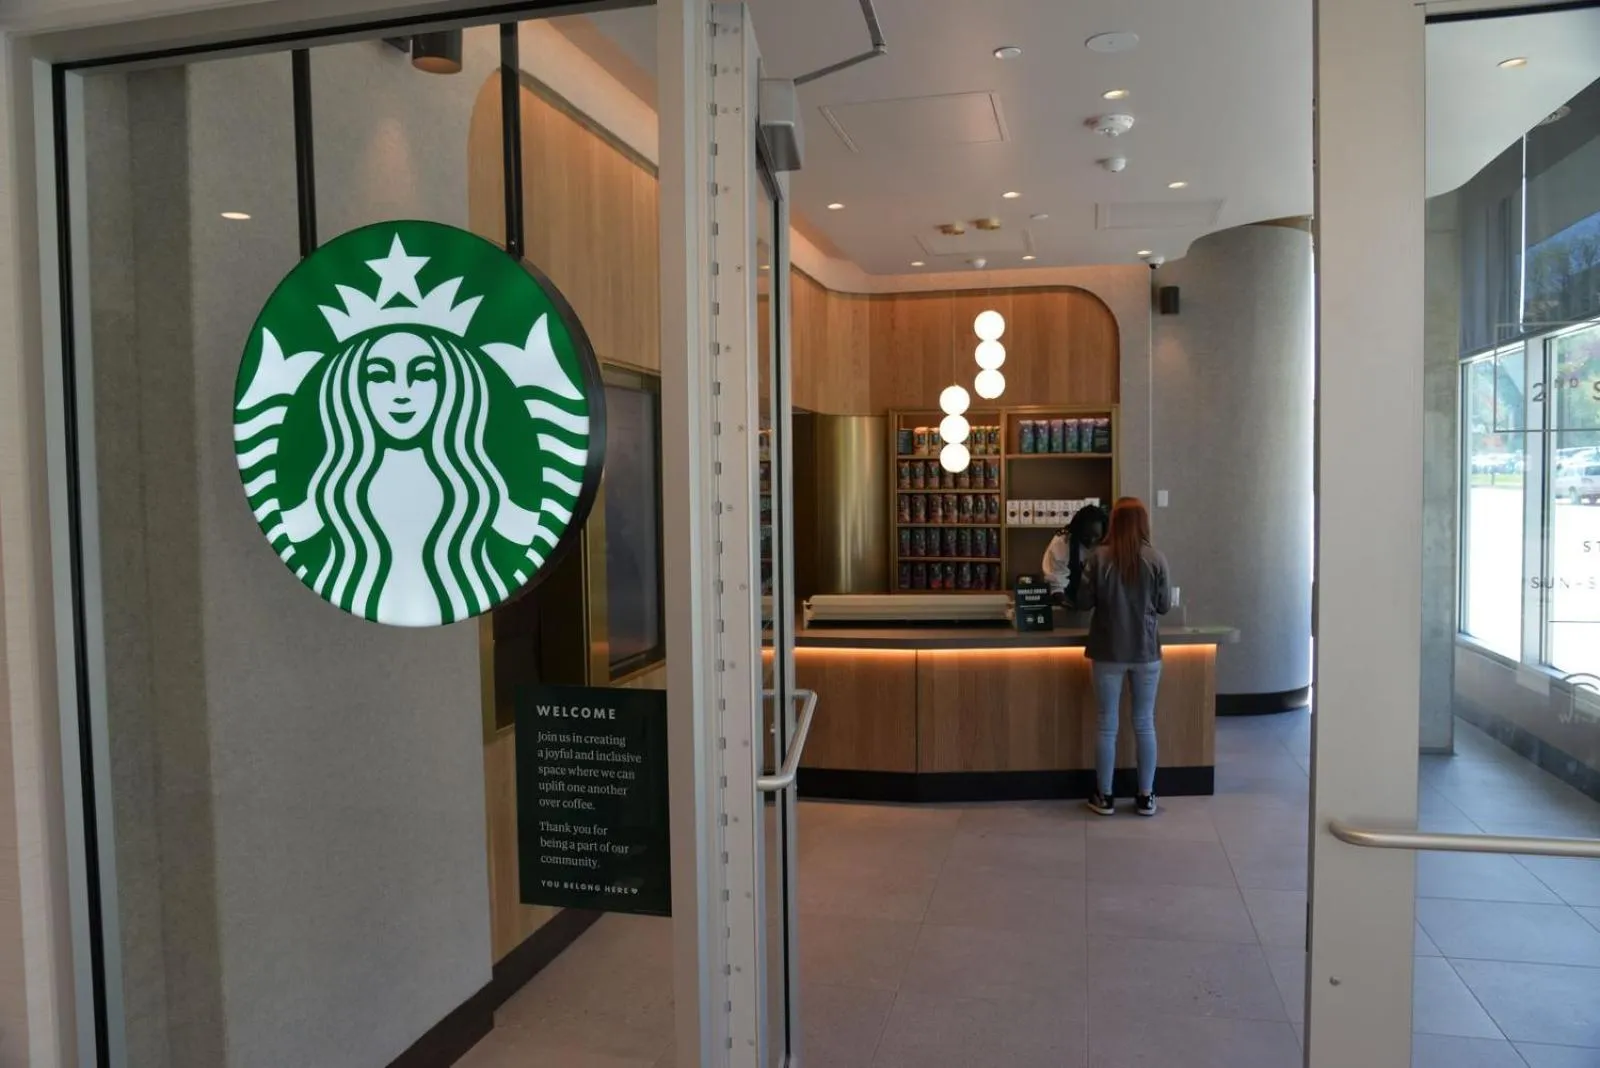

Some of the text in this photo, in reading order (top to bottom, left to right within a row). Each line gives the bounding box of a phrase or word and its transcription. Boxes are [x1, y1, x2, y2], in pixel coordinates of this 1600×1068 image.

[536, 705, 616, 720] WELCOME
[538, 731, 626, 748] Join us in creating
[537, 748, 642, 763] a joyful and inclusive
[538, 765, 635, 780] space where we can
[538, 781, 628, 796] uplift one another
[539, 797, 596, 810] over coffee.
[539, 821, 608, 836] Thank you for
[540, 836, 630, 854] being a part of our
[540, 855, 600, 870] community.
[541, 880, 628, 894] YOU BELONG HERE
